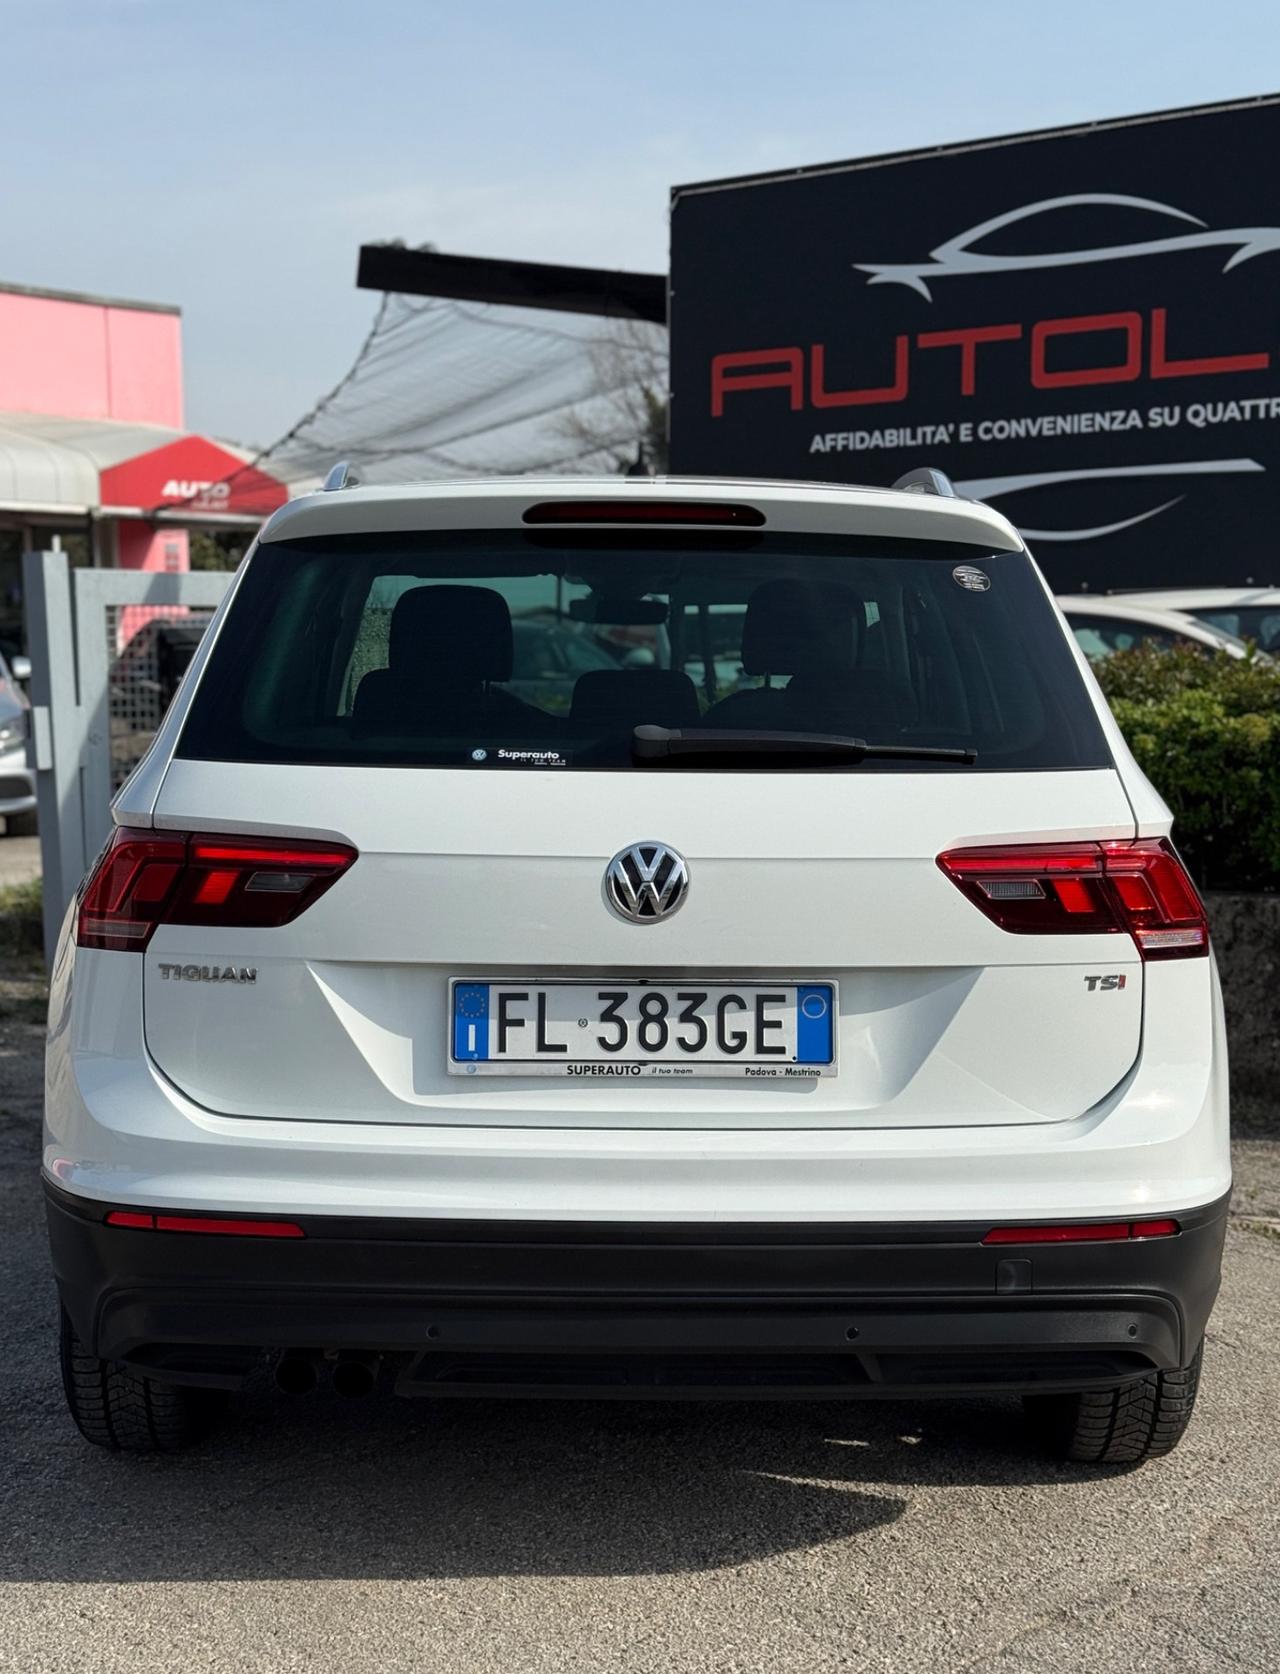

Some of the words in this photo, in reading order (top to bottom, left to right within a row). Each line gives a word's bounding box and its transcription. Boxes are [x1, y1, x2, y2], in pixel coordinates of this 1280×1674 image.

[711, 308, 1269, 417] AUTOL
[810, 423, 954, 453] AFFIDABILITA'
[959, 423, 973, 442] E
[977, 409, 1143, 440] CONVENIENZA
[1148, 405, 1180, 428] SU
[162, 480, 231, 498] AUTO
[497, 749, 559, 760] Superauto
[158, 963, 258, 983] TIGUAN
[1084, 974, 1126, 991] TSI
[498, 992, 567, 1053] FL
[597, 992, 786, 1054] 383GE
[468, 1024, 476, 1051] I
[567, 1065, 641, 1076] SUPERAUTO
[652, 1066, 657, 1074] il
[745, 1067, 777, 1077] Padova
[785, 1067, 821, 1077] Mestrino
